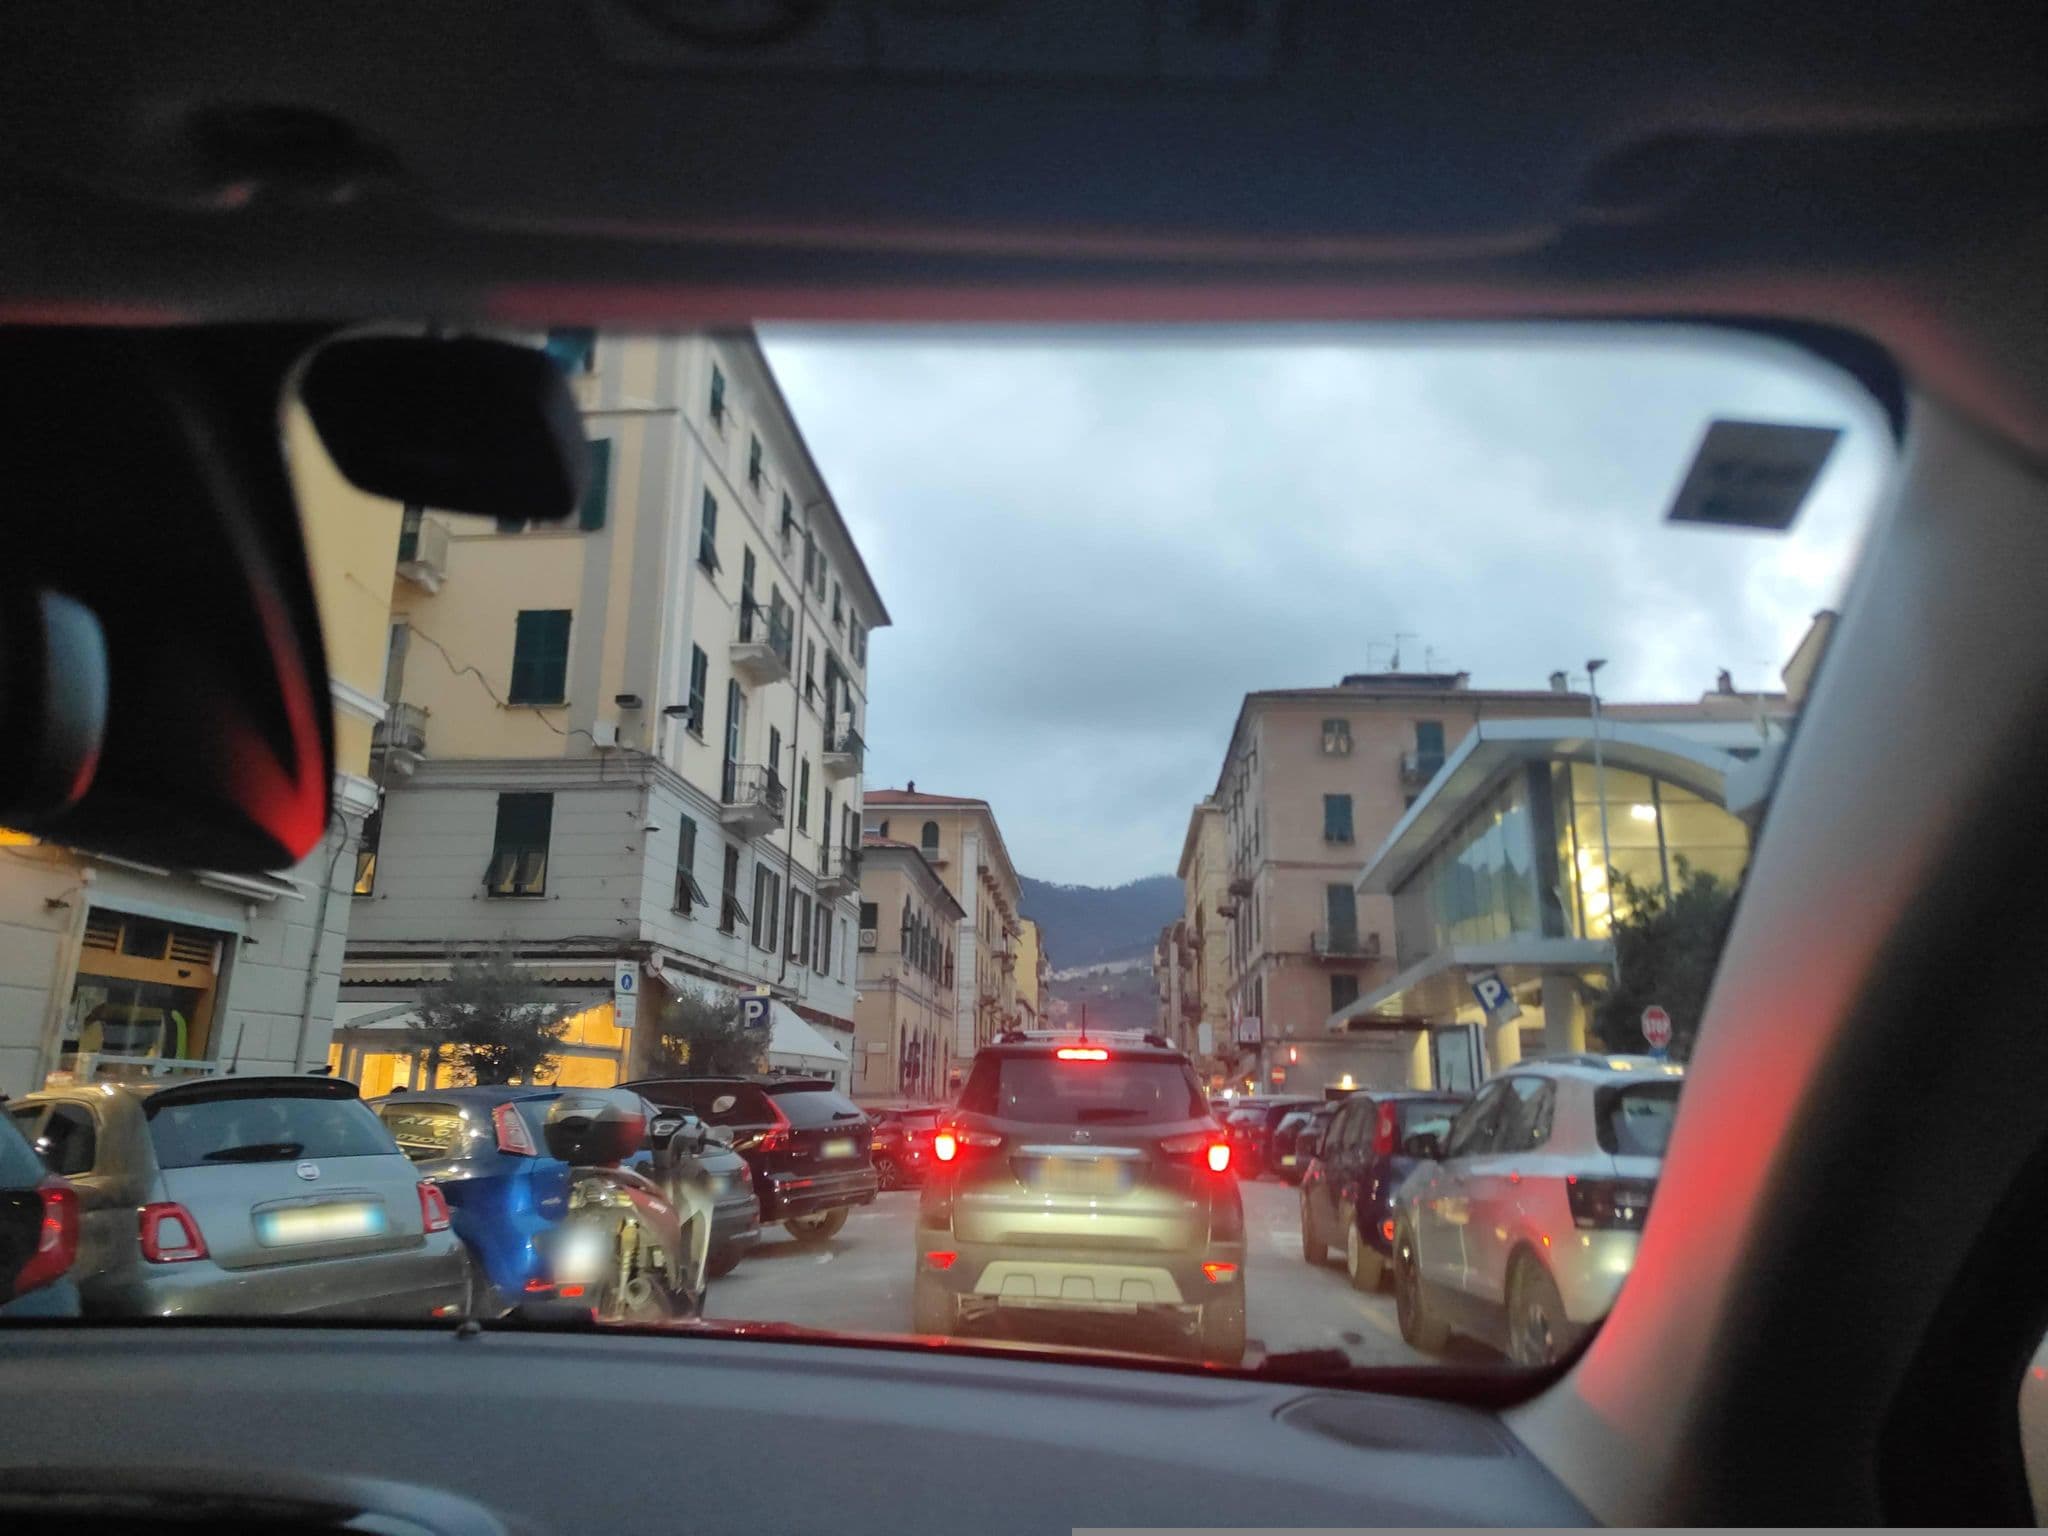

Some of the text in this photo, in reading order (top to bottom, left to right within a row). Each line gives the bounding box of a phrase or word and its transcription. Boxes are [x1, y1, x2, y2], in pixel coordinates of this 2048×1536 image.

[1478, 979, 1501, 1009] P
[744, 1000, 763, 1027] P
[1643, 1019, 1670, 1033] STOP
